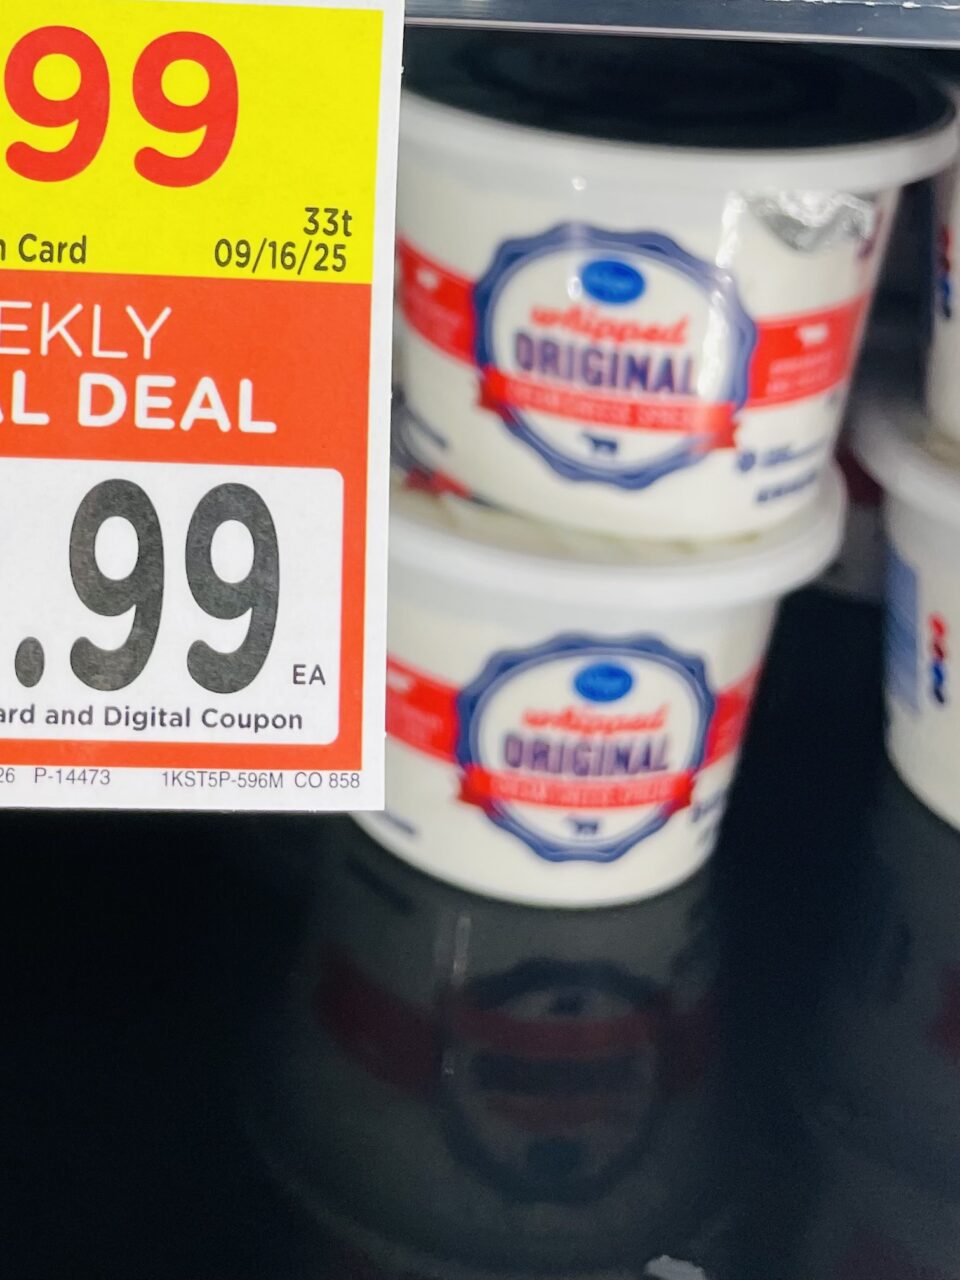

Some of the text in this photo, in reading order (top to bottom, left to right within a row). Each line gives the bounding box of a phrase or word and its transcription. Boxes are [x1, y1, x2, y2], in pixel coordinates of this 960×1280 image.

[302, 206, 353, 239] 33t
[18, 233, 88, 266] Card
[213, 238, 348, 277] 09/16/25
[78, 373, 278, 435] DEAL
[293, 664, 327, 687] EA
[45, 703, 95, 728] and
[103, 704, 193, 733] Digital
[201, 708, 304, 738] Coupon
[33, 768, 111, 786] P-14473
[294, 772, 323, 790] CO
[328, 772, 361, 790] 858
